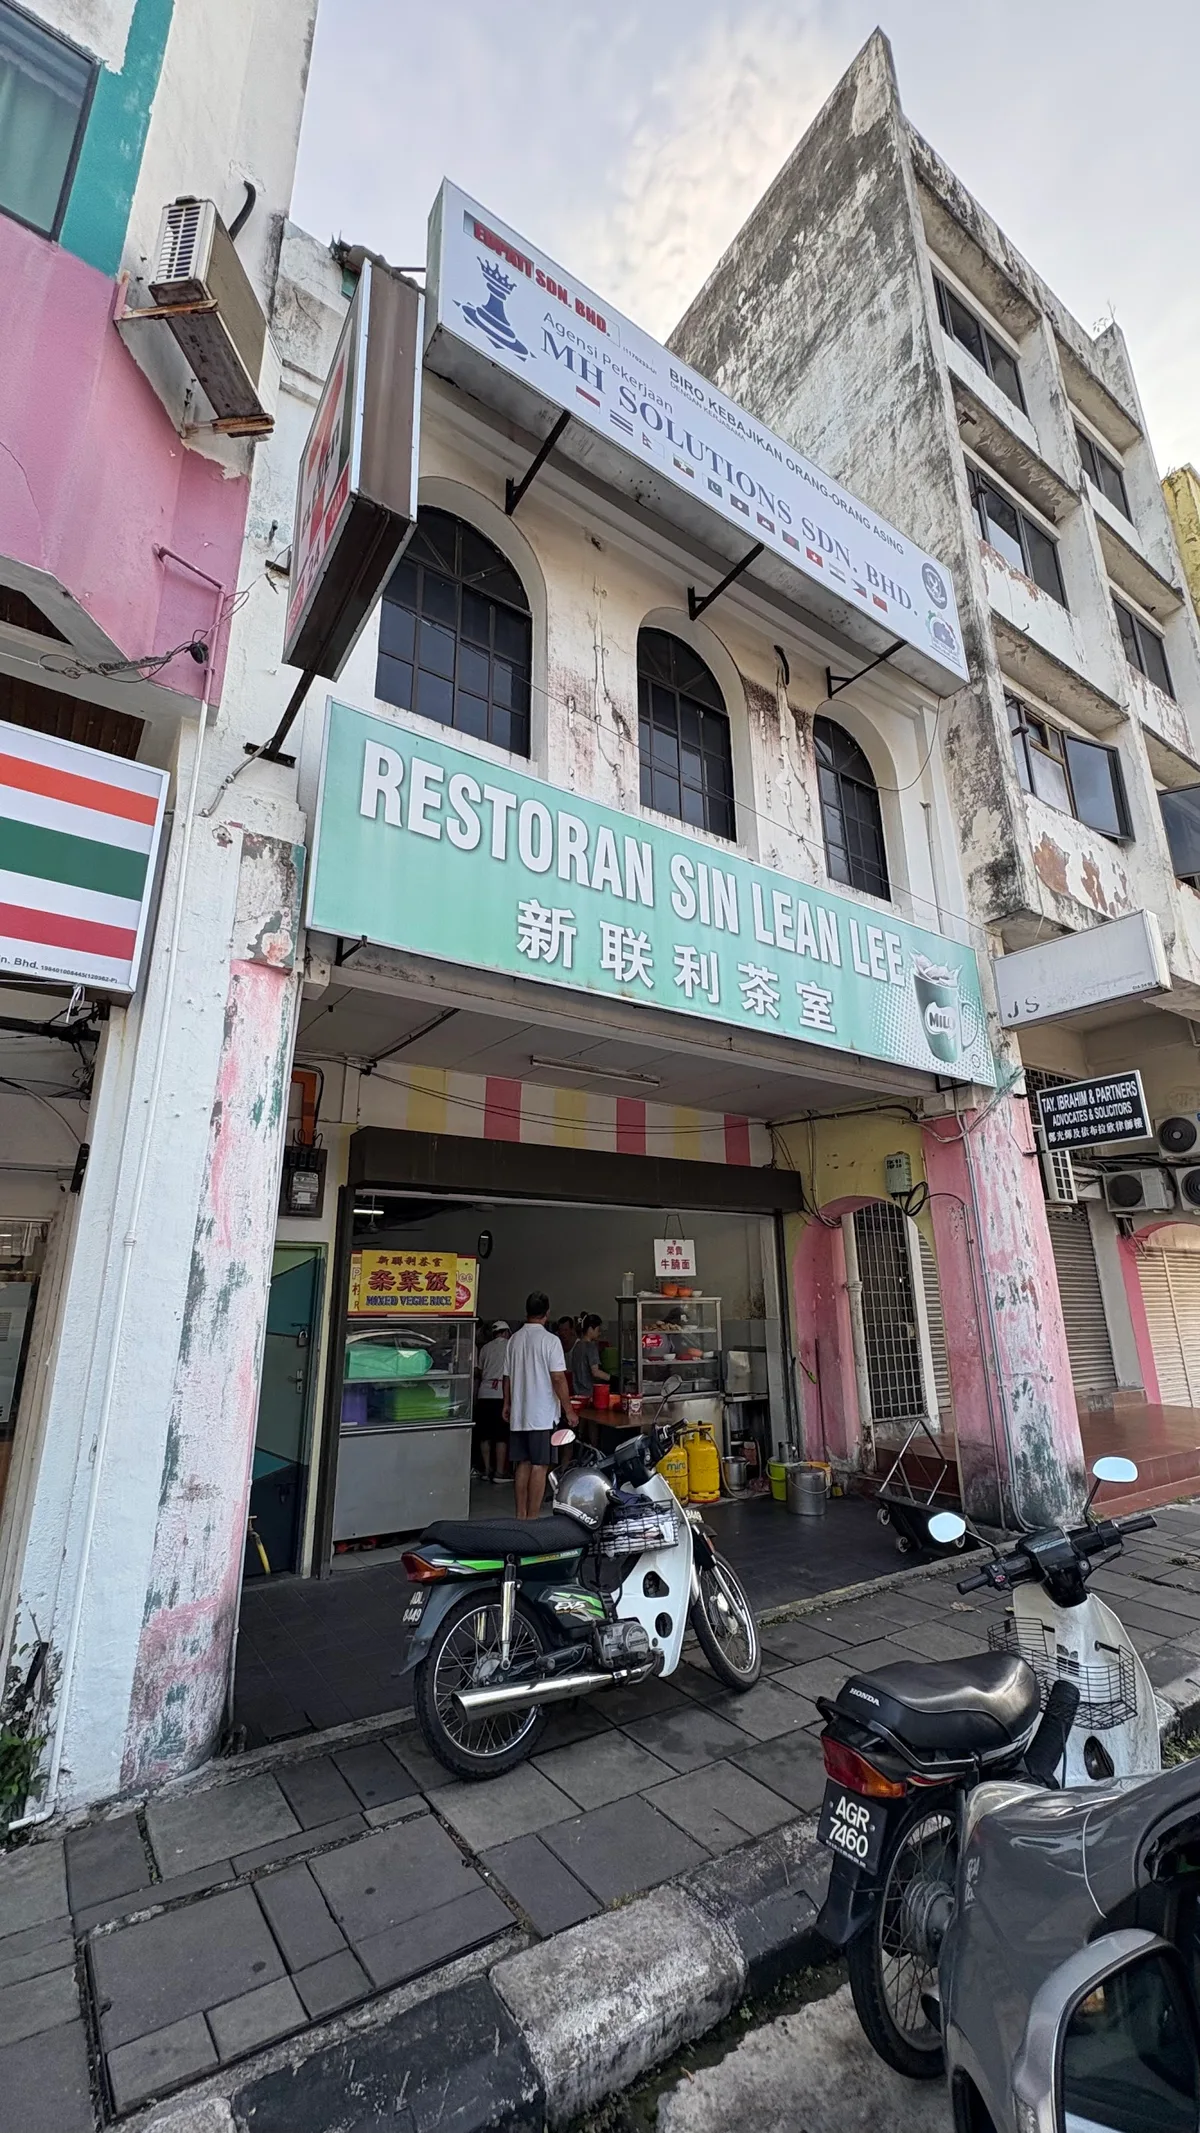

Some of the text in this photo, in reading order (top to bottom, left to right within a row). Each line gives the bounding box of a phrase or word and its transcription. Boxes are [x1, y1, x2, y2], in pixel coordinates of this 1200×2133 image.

[535, 268, 572, 308] SDN.
[575, 297, 611, 337] BHD.
[543, 312, 674, 414] Agensi Pekerjaan
[541, 326, 606, 395] MH
[619, 385, 792, 525] SOLUTIONS
[802, 516, 858, 573] SDN.
[864, 561, 918, 616] BHD.
[670, 367, 904, 555] BIRO KEBAJIKAN ORANG-ORANG ASING
[360, 739, 906, 987] RESTORAN SIN LEAN LEE
[14, 957, 39, 970] Bhd.
[517, 899, 837, 1033] 新联利茶室
[1041, 1080, 1138, 1113] TAY. IBRAHIM & PARTNERS
[1053, 1101, 1133, 1127] ADVOCATES & SOLICITORS
[366, 1296, 399, 1306] MIXED
[430, 1296, 452, 1306] RICE
[580, 1512, 597, 1526] SGV
[402, 1608, 422, 1622] 8449
[555, 1600, 586, 1611] EX5
[849, 1687, 880, 1707] HONDA
[835, 1796, 870, 1833] AGR
[829, 1816, 869, 1858] 7460
